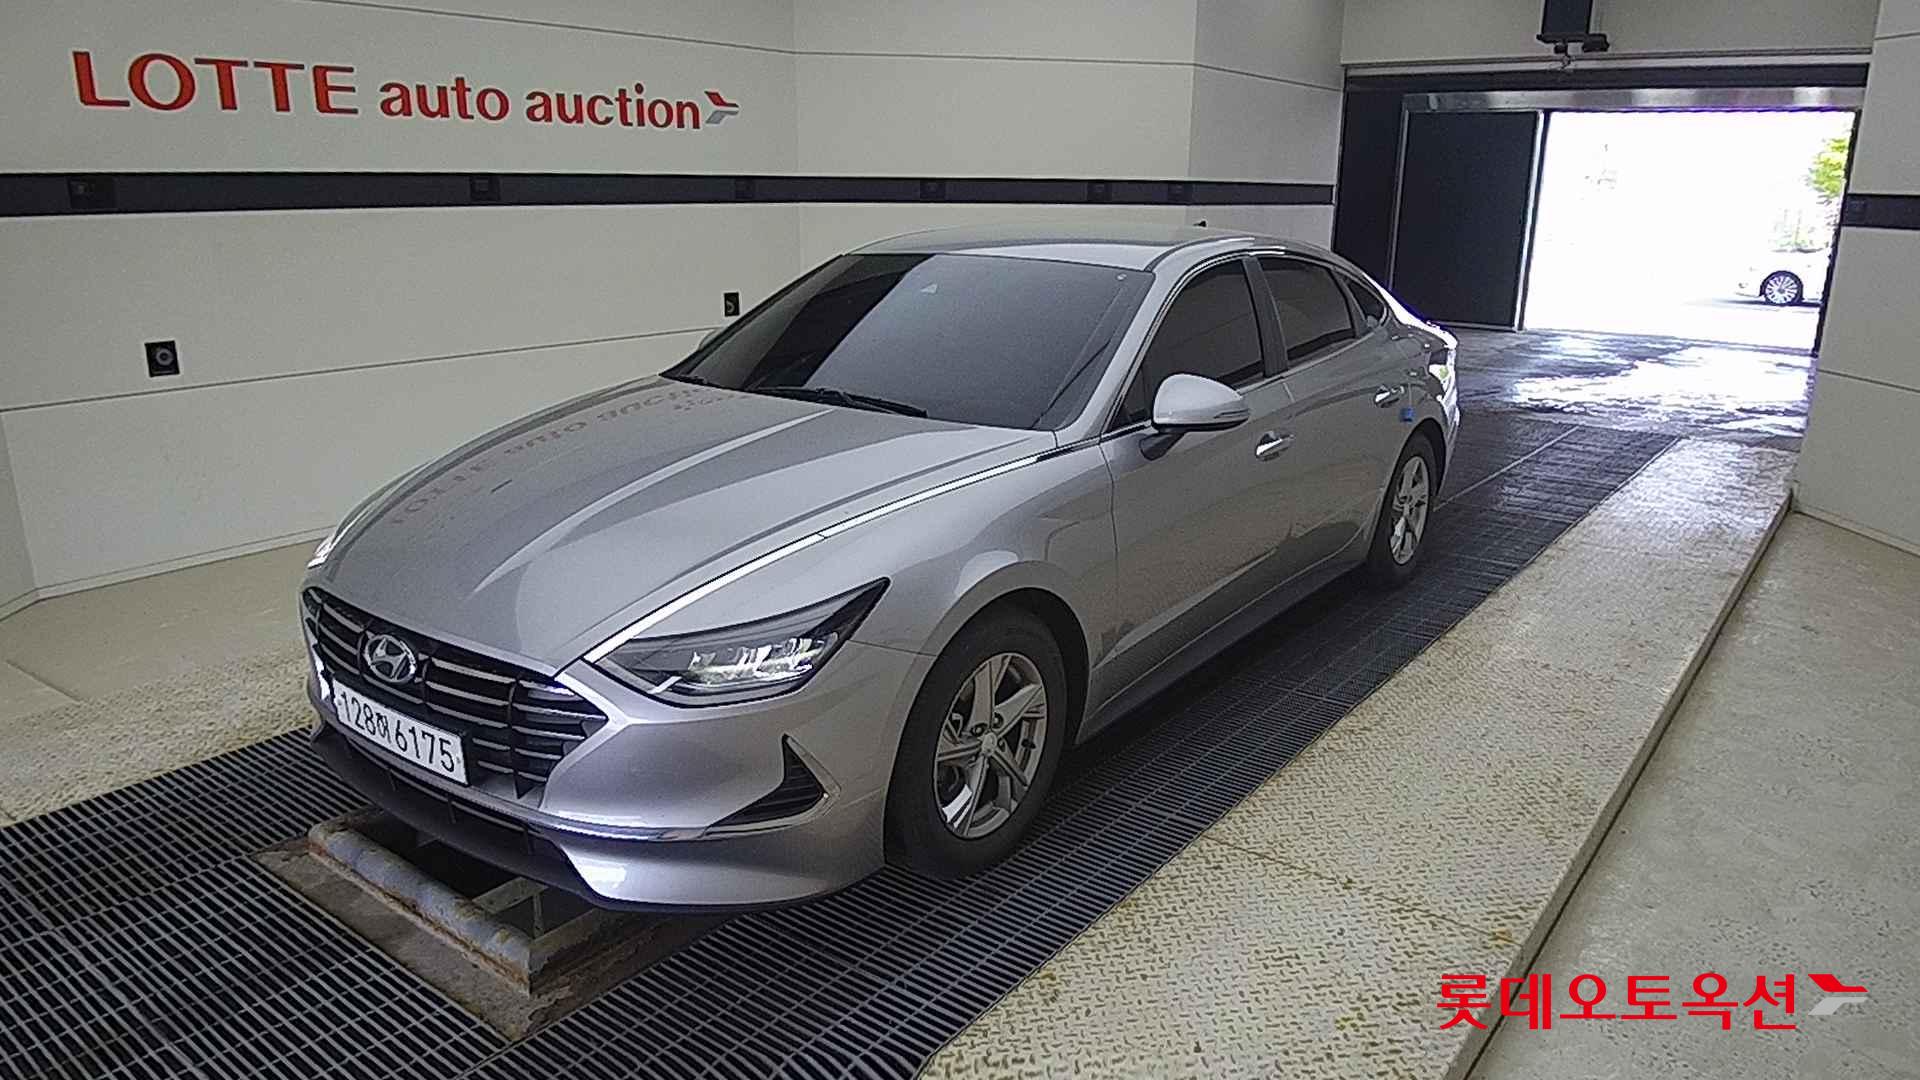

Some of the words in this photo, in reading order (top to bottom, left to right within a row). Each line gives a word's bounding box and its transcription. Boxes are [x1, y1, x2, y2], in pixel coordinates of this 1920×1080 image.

[72, 51, 359, 113] LOTTE
[379, 77, 509, 121] auto
[525, 83, 701, 129] auction
